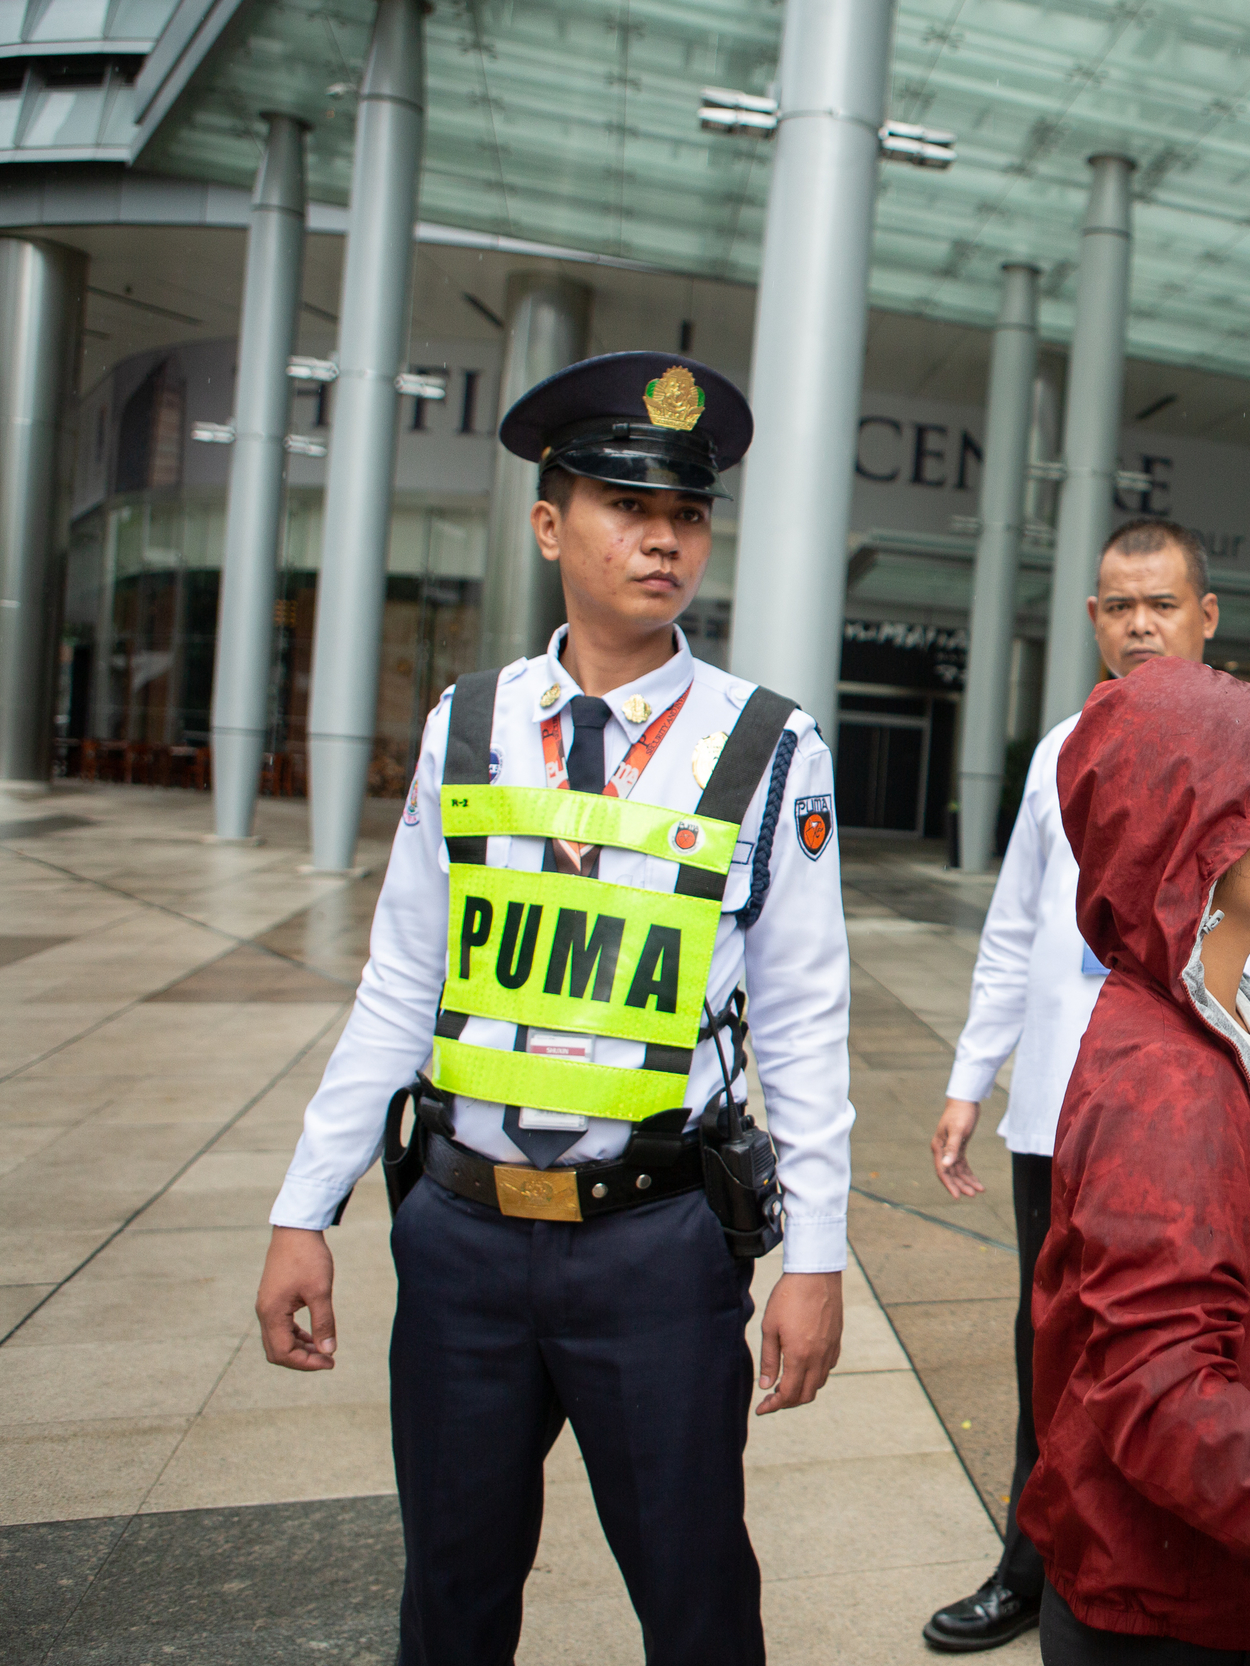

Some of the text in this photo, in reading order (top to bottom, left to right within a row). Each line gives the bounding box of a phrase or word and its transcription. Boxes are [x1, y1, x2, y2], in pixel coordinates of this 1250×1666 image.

[646, 723, 668, 756] SECURITY
[451, 798, 469, 808] R-2
[798, 798, 830, 815] PUMA
[459, 895, 682, 1014] PUMA
